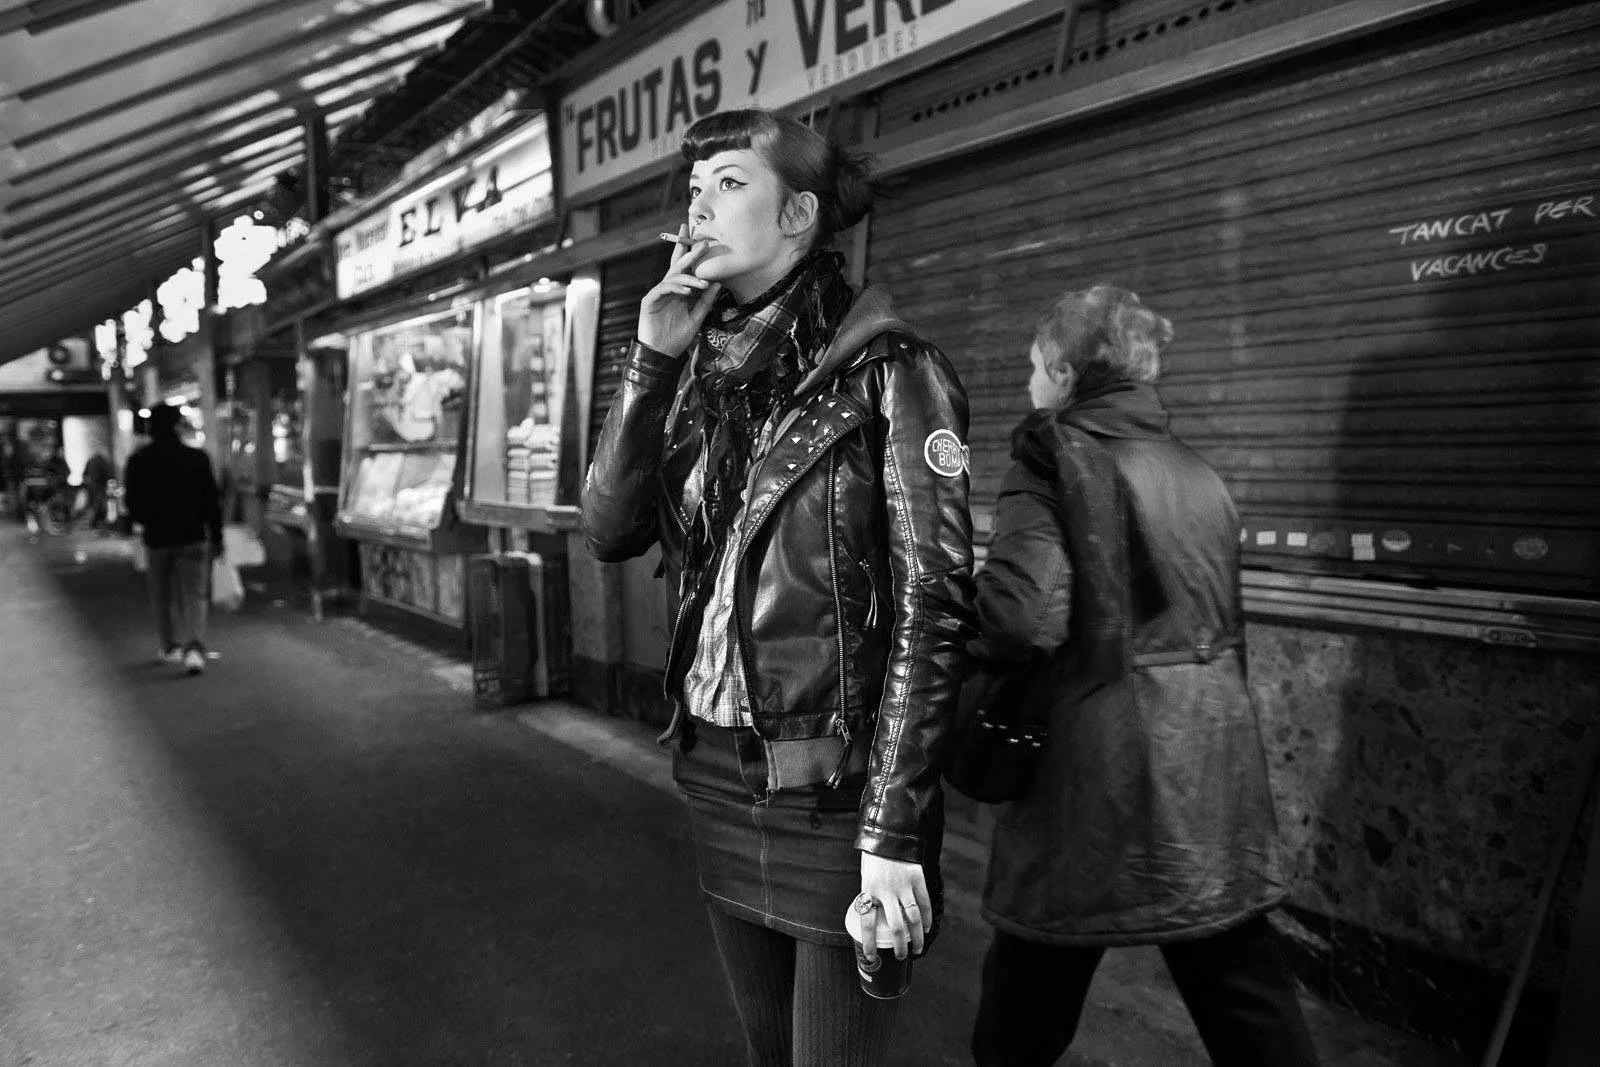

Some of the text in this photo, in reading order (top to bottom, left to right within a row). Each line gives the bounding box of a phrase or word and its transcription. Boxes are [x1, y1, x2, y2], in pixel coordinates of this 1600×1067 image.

[1388, 196, 1597, 245] TANCAT PER
[1410, 242, 1547, 282] VACANCES
